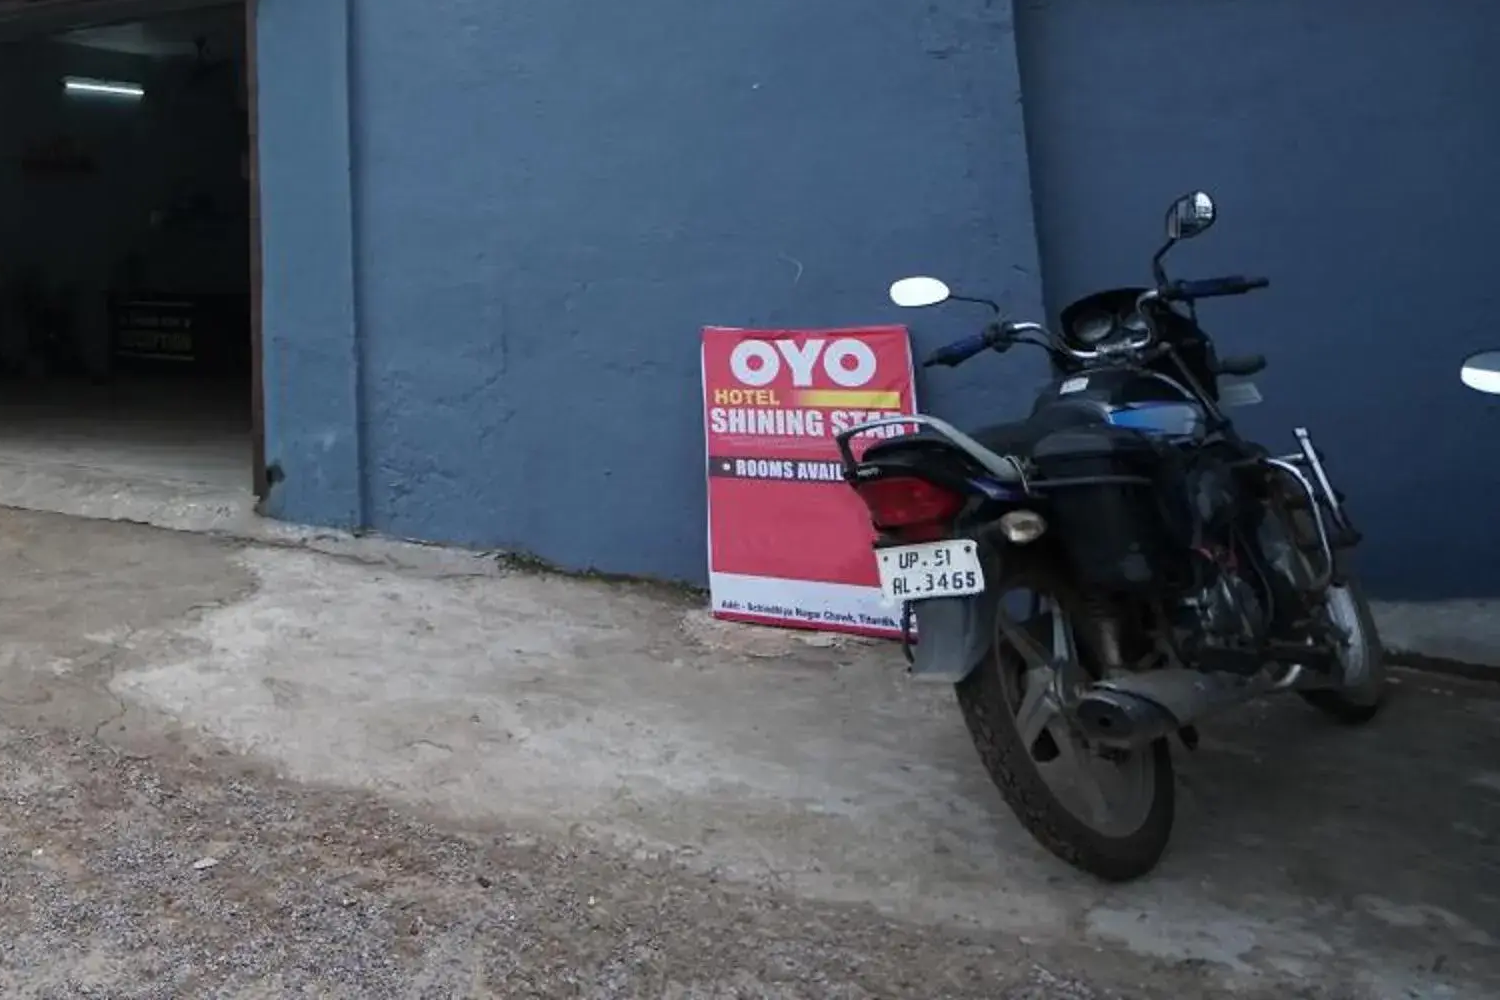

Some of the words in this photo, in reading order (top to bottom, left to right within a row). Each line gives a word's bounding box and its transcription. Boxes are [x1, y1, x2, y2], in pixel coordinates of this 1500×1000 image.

[730, 338, 876, 387] OYO
[714, 388, 780, 406] HOTEL
[711, 407, 825, 437] SHINING
[735, 459, 794, 478] ROOMS
[797, 462, 845, 481] AVAIL
